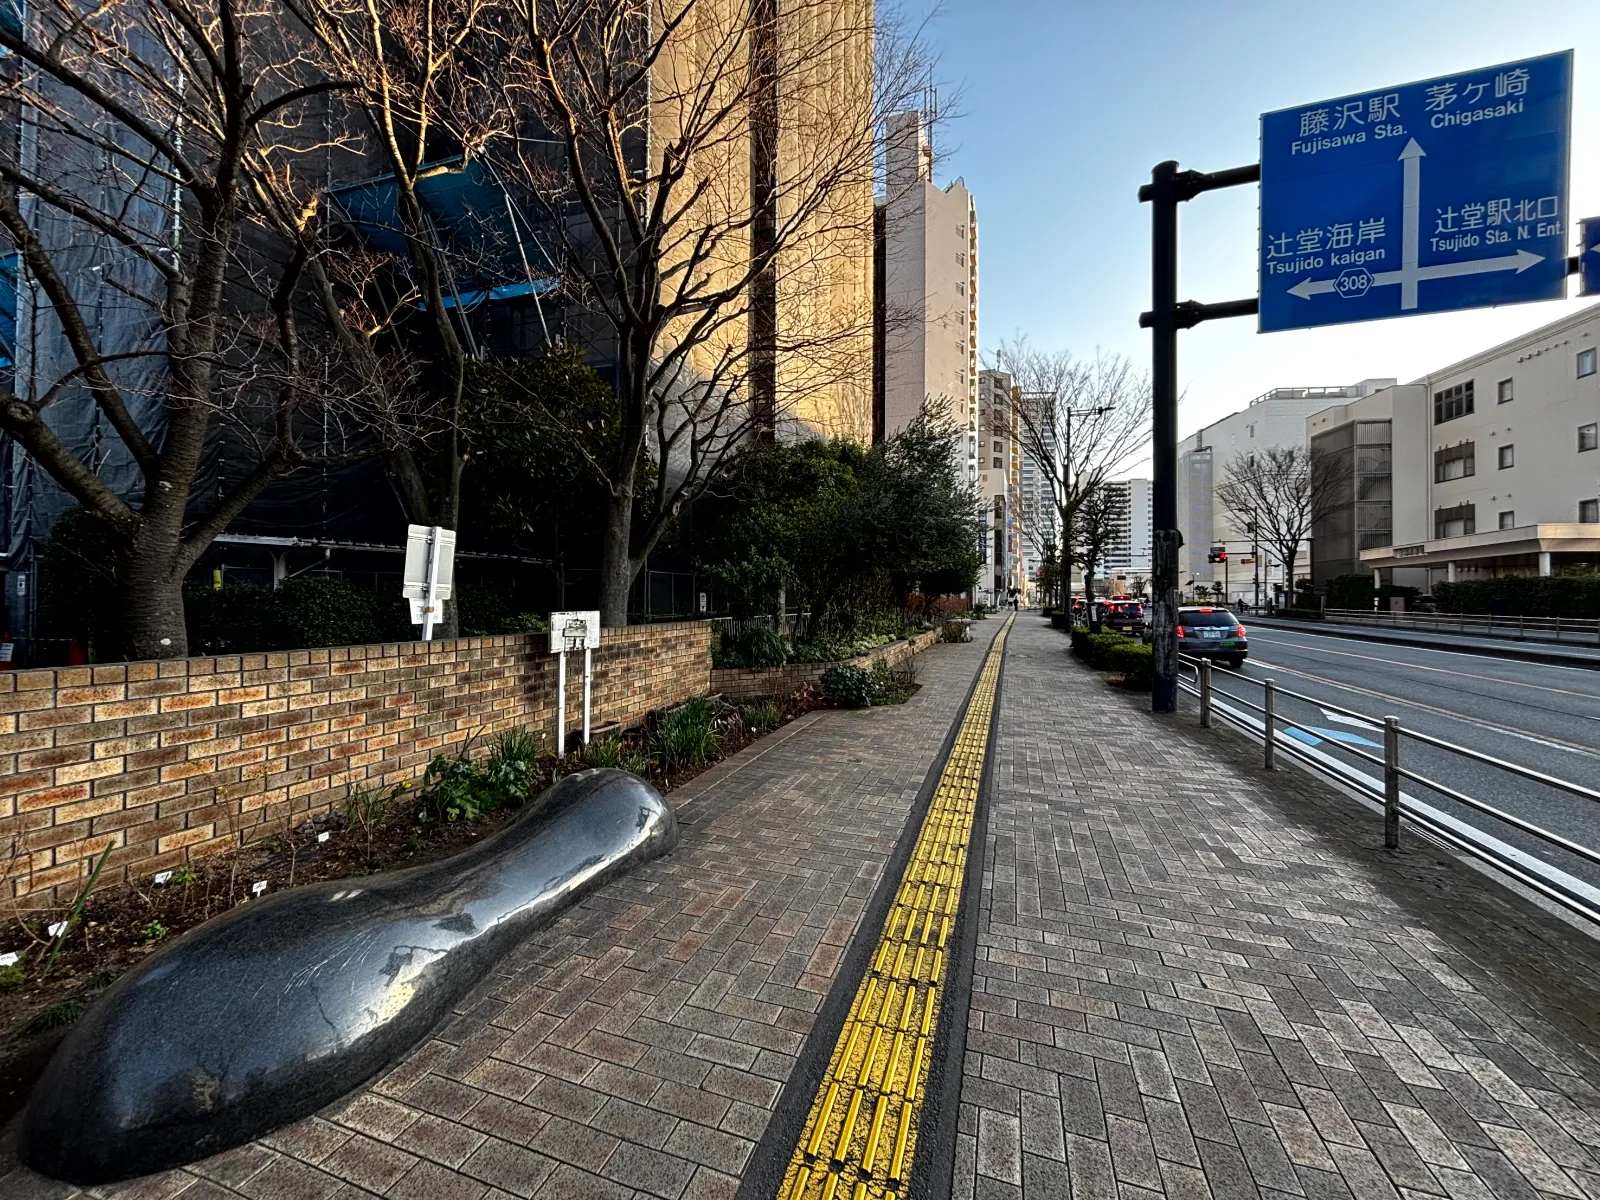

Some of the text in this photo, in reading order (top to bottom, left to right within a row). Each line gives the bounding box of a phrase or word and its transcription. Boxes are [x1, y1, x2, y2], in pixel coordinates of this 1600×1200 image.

[1299, 93, 1400, 137] 藤沢駅
[1430, 98, 1523, 128] Chigasaki
[1291, 123, 1408, 155] Fujisawa Sta.
[1434, 196, 1558, 234] 辻堂駅北口
[1267, 217, 1385, 259] 辻堂海岸
[1430, 221, 1564, 252] Tsujido Sta. N. Ent.
[1266, 248, 1385, 274] Tsujido kaigan
[1340, 275, 1368, 291] 308
